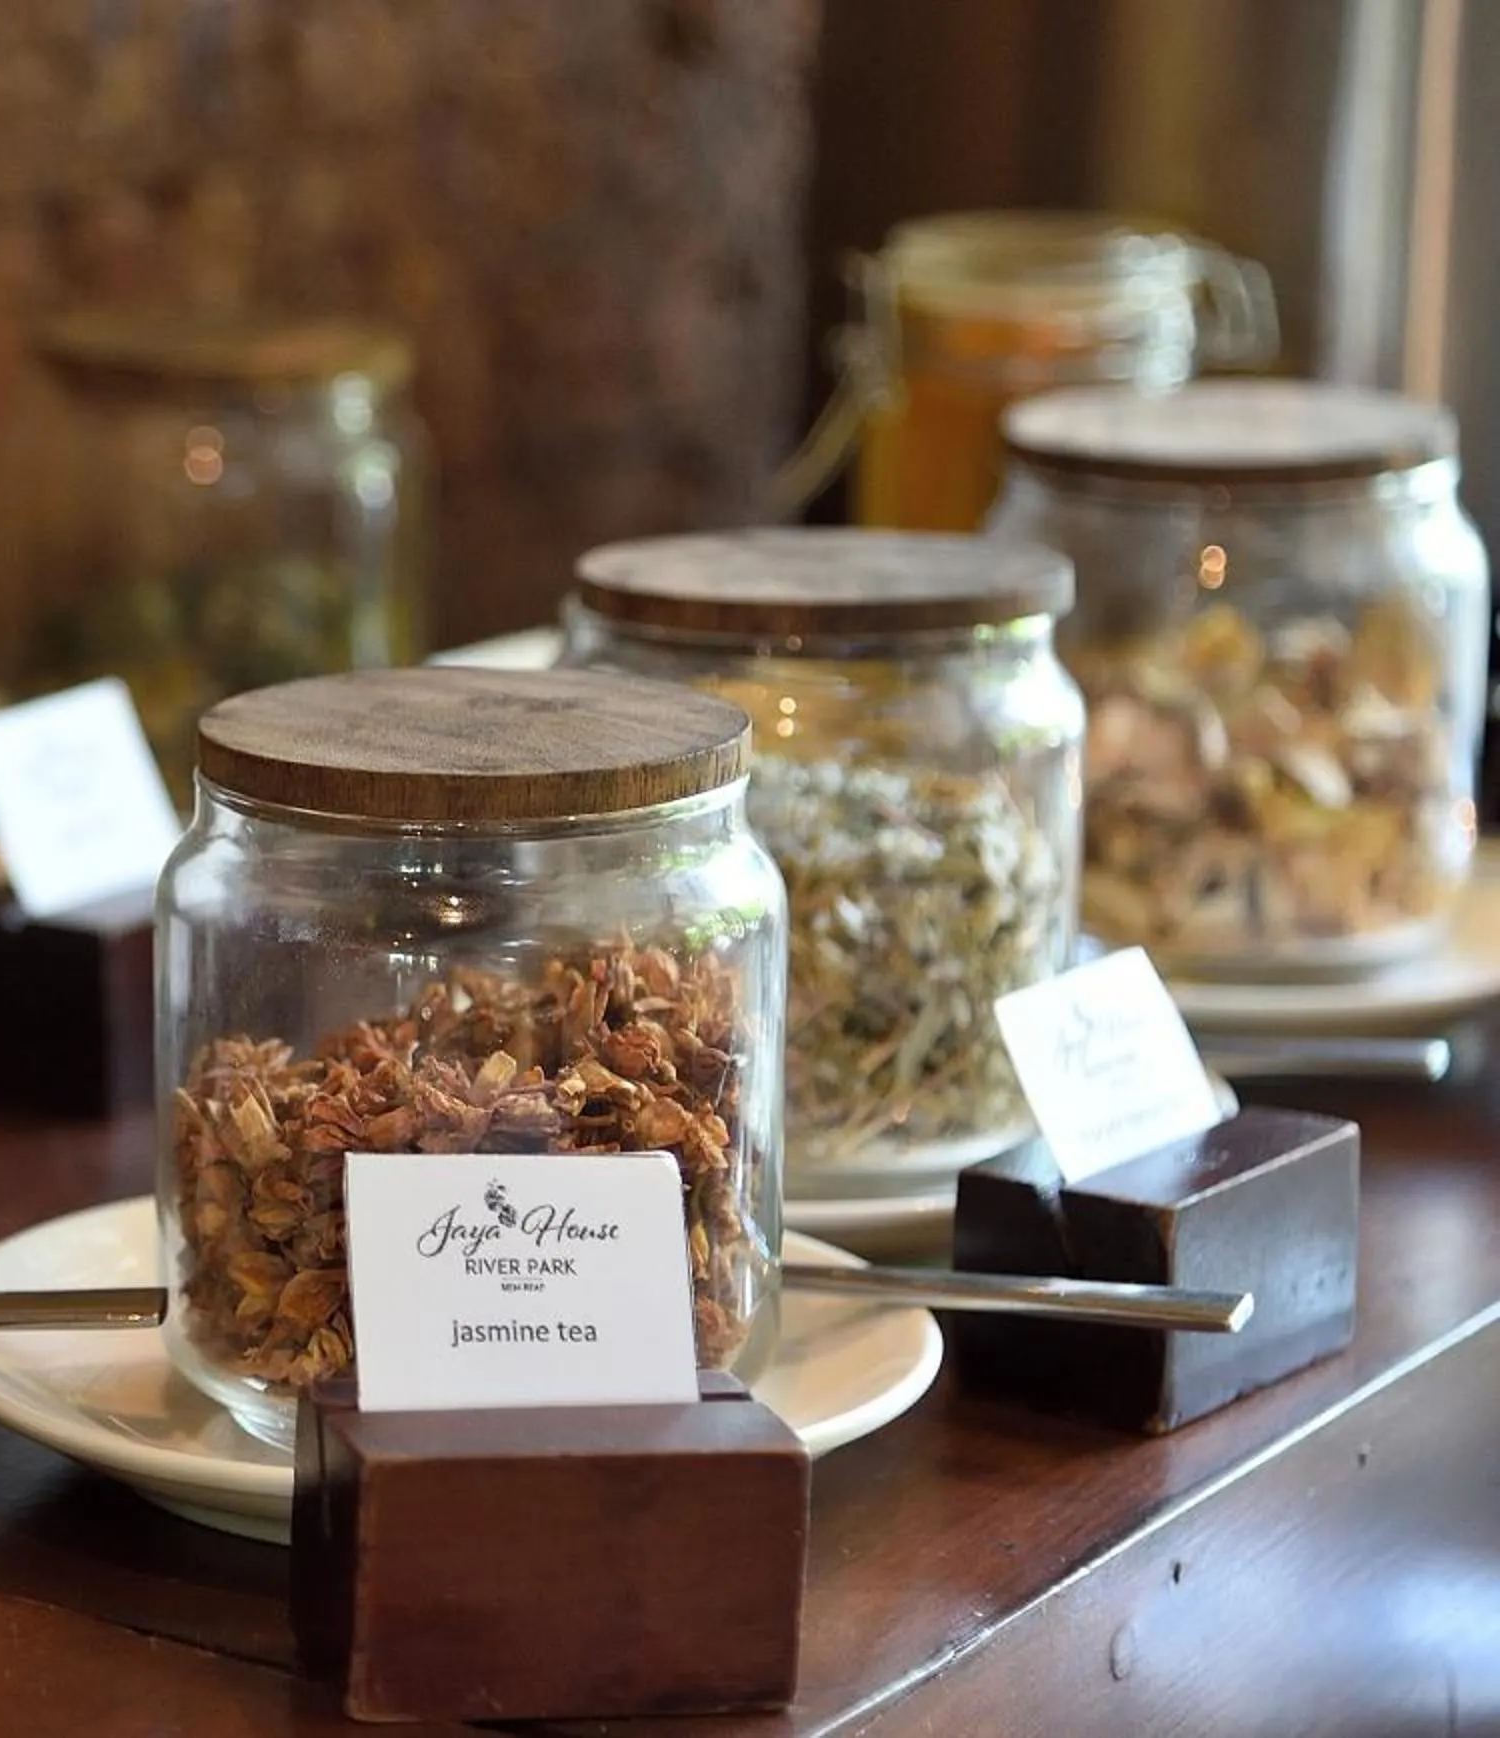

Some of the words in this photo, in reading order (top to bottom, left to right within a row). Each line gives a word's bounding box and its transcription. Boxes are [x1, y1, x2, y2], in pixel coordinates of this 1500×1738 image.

[417, 1205, 500, 1257] Jaya
[521, 1204, 619, 1247] House
[465, 1258, 521, 1275] RIVER
[528, 1258, 577, 1275] PARK
[451, 1320, 550, 1348] jasmine
[558, 1323, 598, 1343] tea
